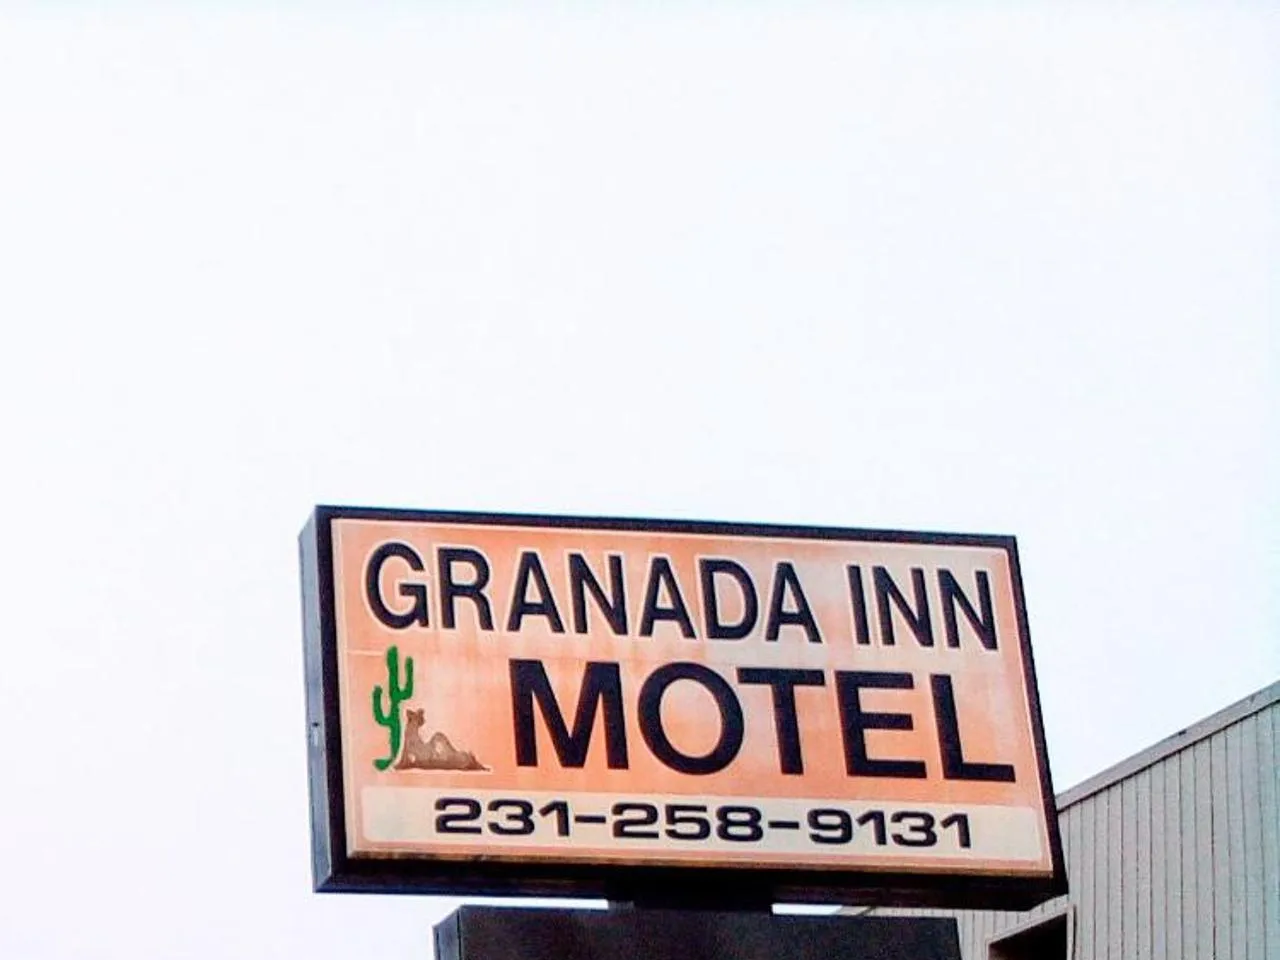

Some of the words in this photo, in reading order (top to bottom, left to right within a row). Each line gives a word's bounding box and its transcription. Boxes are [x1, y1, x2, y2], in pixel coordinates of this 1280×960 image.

[365, 541, 822, 645] GRANADA
[847, 564, 998, 652] INN
[508, 658, 1017, 784] MOTEL
[433, 798, 973, 849] 231-258-9131
